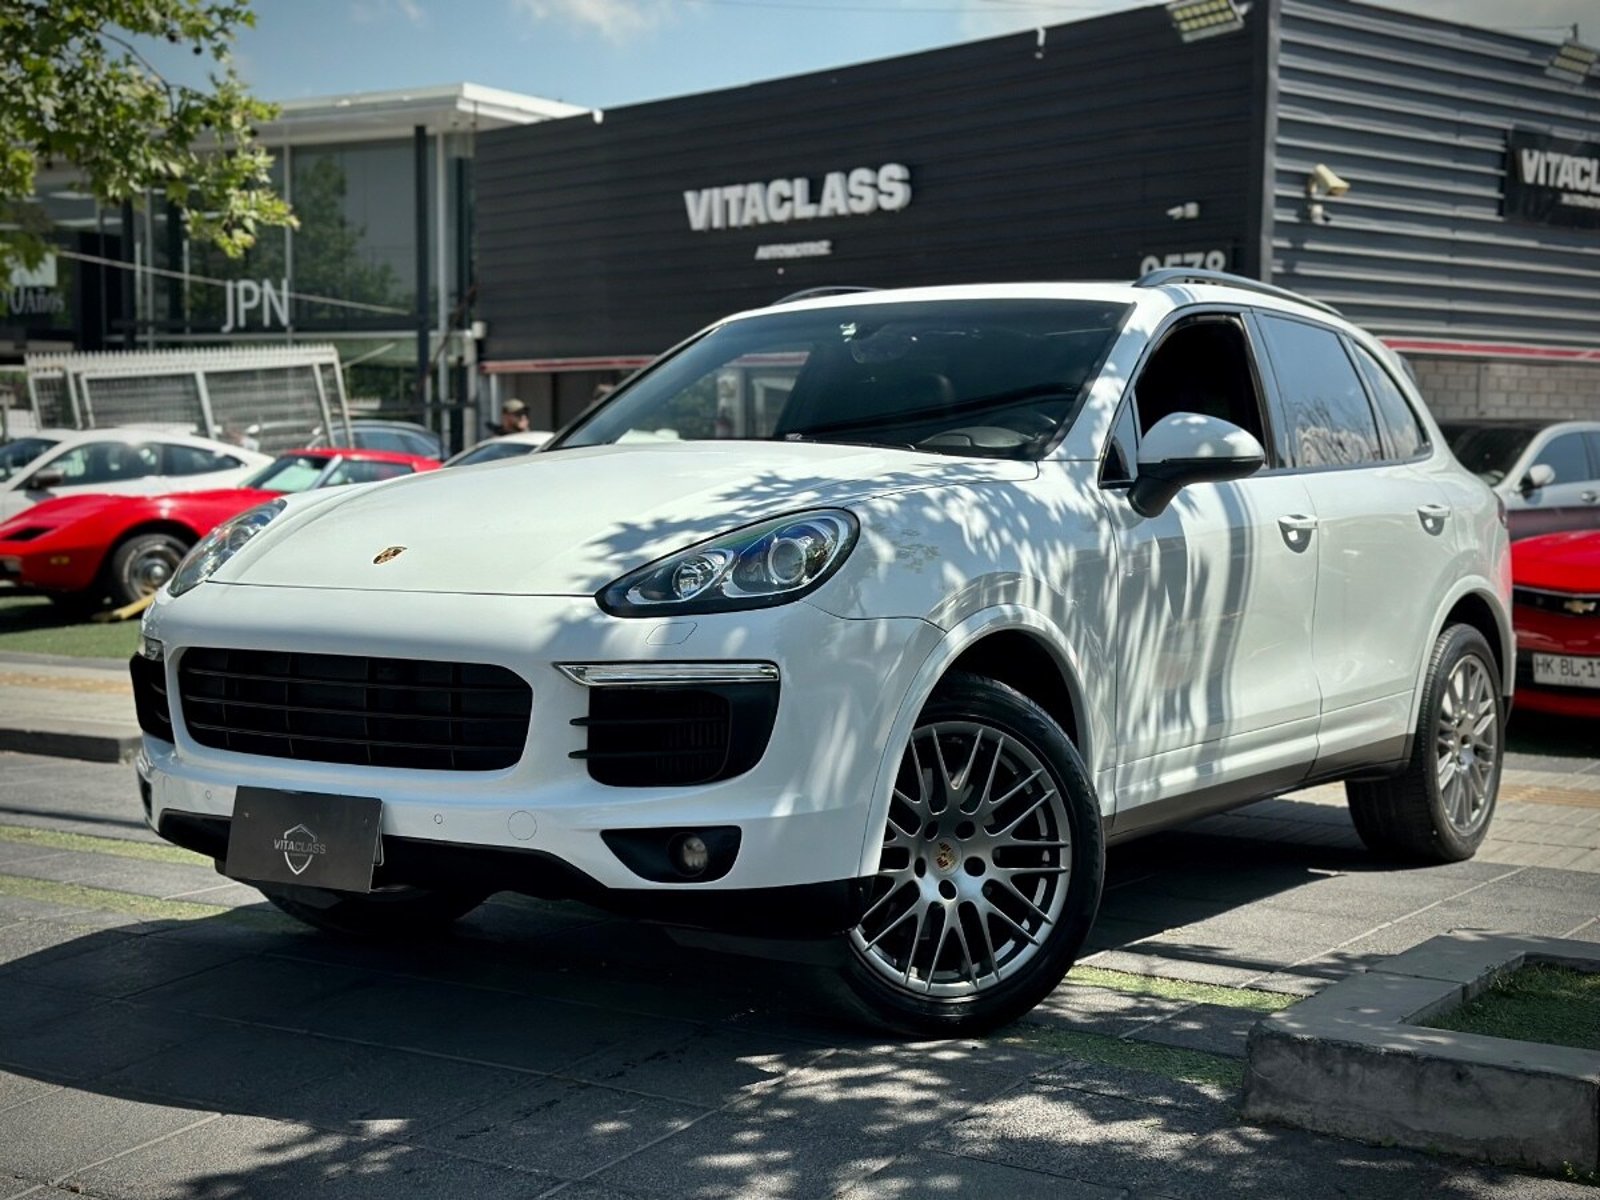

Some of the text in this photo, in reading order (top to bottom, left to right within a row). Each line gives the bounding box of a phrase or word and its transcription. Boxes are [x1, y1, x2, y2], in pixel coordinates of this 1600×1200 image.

[684, 163, 912, 231] VITACLASS
[221, 278, 289, 333] JPN
[273, 838, 327, 854] VITACLASS
